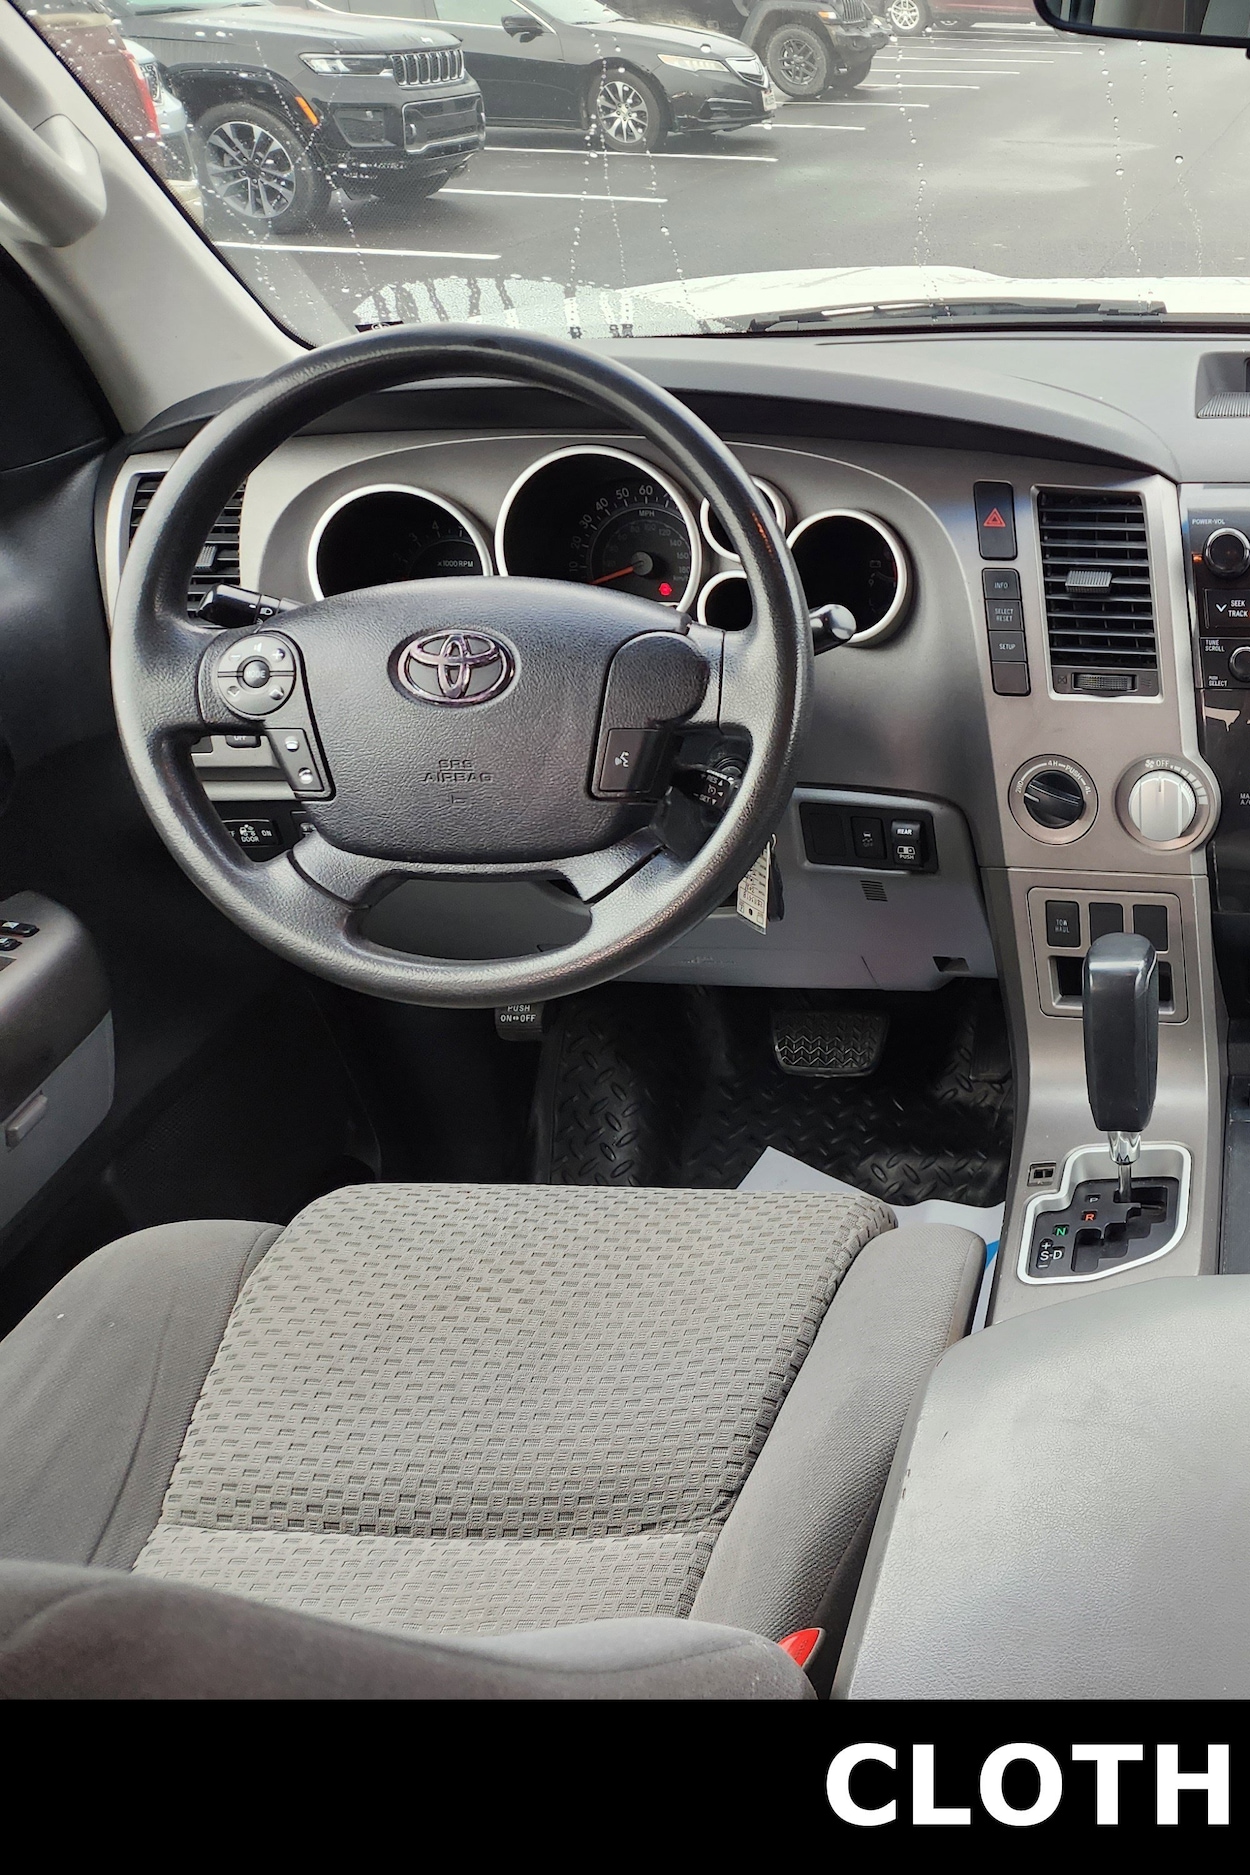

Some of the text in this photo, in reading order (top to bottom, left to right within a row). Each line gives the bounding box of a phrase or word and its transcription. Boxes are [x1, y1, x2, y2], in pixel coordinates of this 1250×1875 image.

[616, 487, 630, 499] 50
[639, 485, 653, 495] 60
[595, 497, 609, 511] 40
[580, 514, 593, 529] 30
[569, 561, 578, 572] 10
[1228, 610, 1248, 618] TRACK
[438, 759, 474, 770] SRS
[1155, 759, 1170, 768] OFF
[423, 772, 494, 783] AIRBAG
[1064, 764, 1082, 781] PUSH
[1085, 1213, 1095, 1221] R
[1056, 1227, 1067, 1236] N
